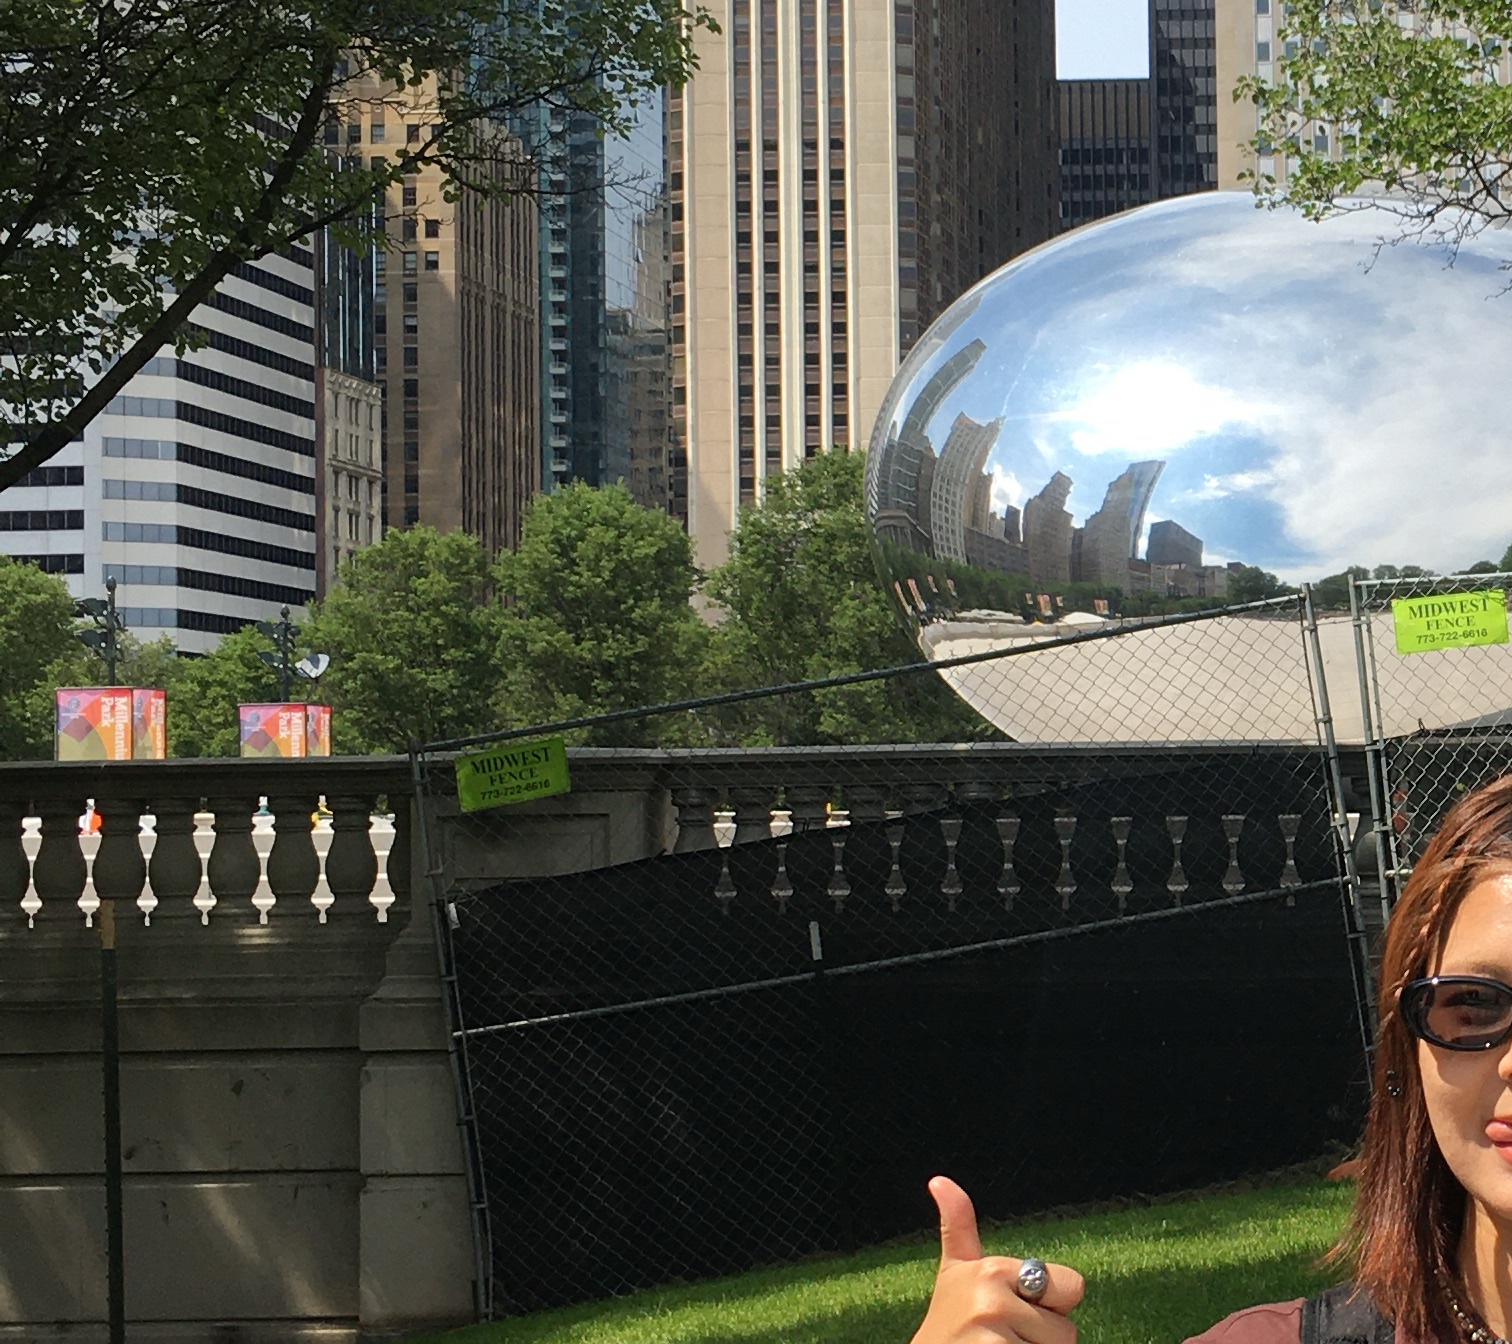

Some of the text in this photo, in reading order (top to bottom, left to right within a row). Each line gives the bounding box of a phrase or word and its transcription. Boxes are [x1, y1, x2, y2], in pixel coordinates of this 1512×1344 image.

[1408, 598, 1490, 620] MIDWEST
[1426, 616, 1476, 631] FENCE
[1416, 628, 1488, 645] 773-722-6616
[101, 696, 114, 727] Park
[279, 711, 291, 738] Park
[470, 747, 551, 775] MIDWEST
[489, 767, 540, 787] FENCE
